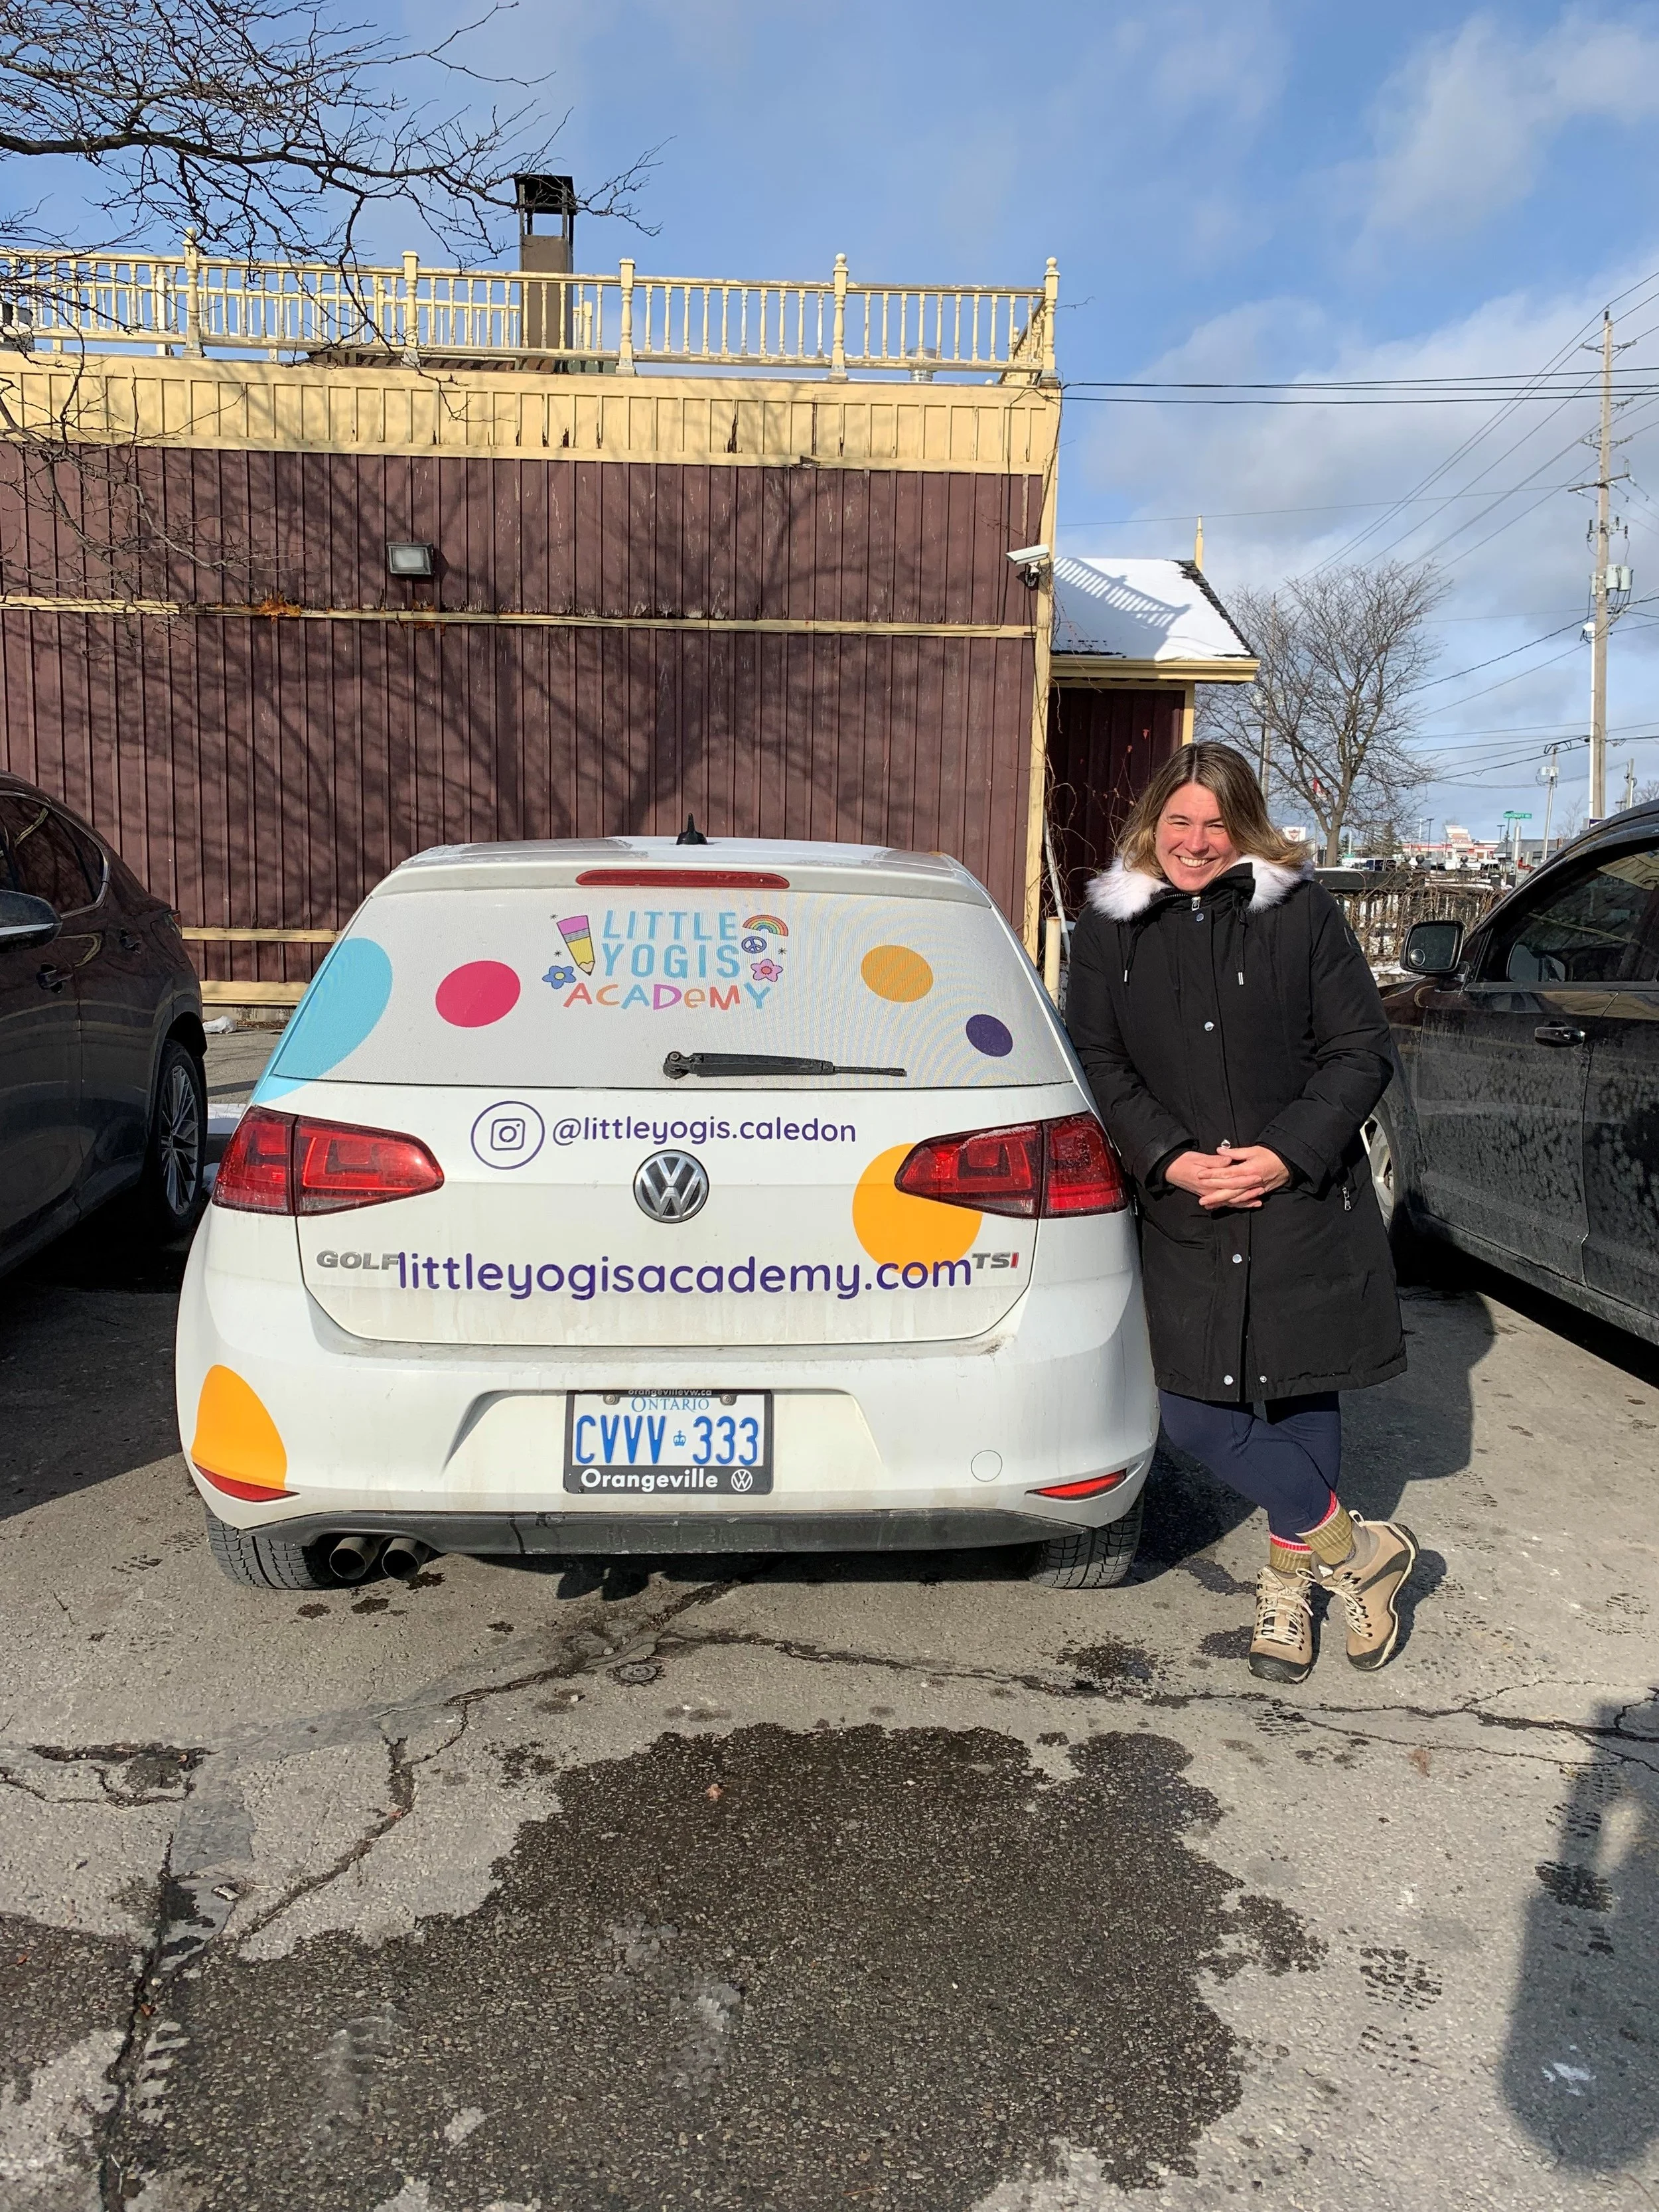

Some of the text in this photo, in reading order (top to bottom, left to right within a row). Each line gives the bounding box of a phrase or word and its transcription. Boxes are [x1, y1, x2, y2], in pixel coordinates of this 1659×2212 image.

[602, 910, 738, 940] LITTLE
[602, 943, 741, 979] YOGIS
[552, 1116, 857, 1146] @littleyogis.caledon
[316, 1250, 399, 1270] GOLF
[972, 1251, 1020, 1270] TSI
[397, 1251, 972, 1301] littleyogisacademy.com
[575, 1415, 759, 1465] CVVV 333
[581, 1468, 718, 1492] Orangeville
